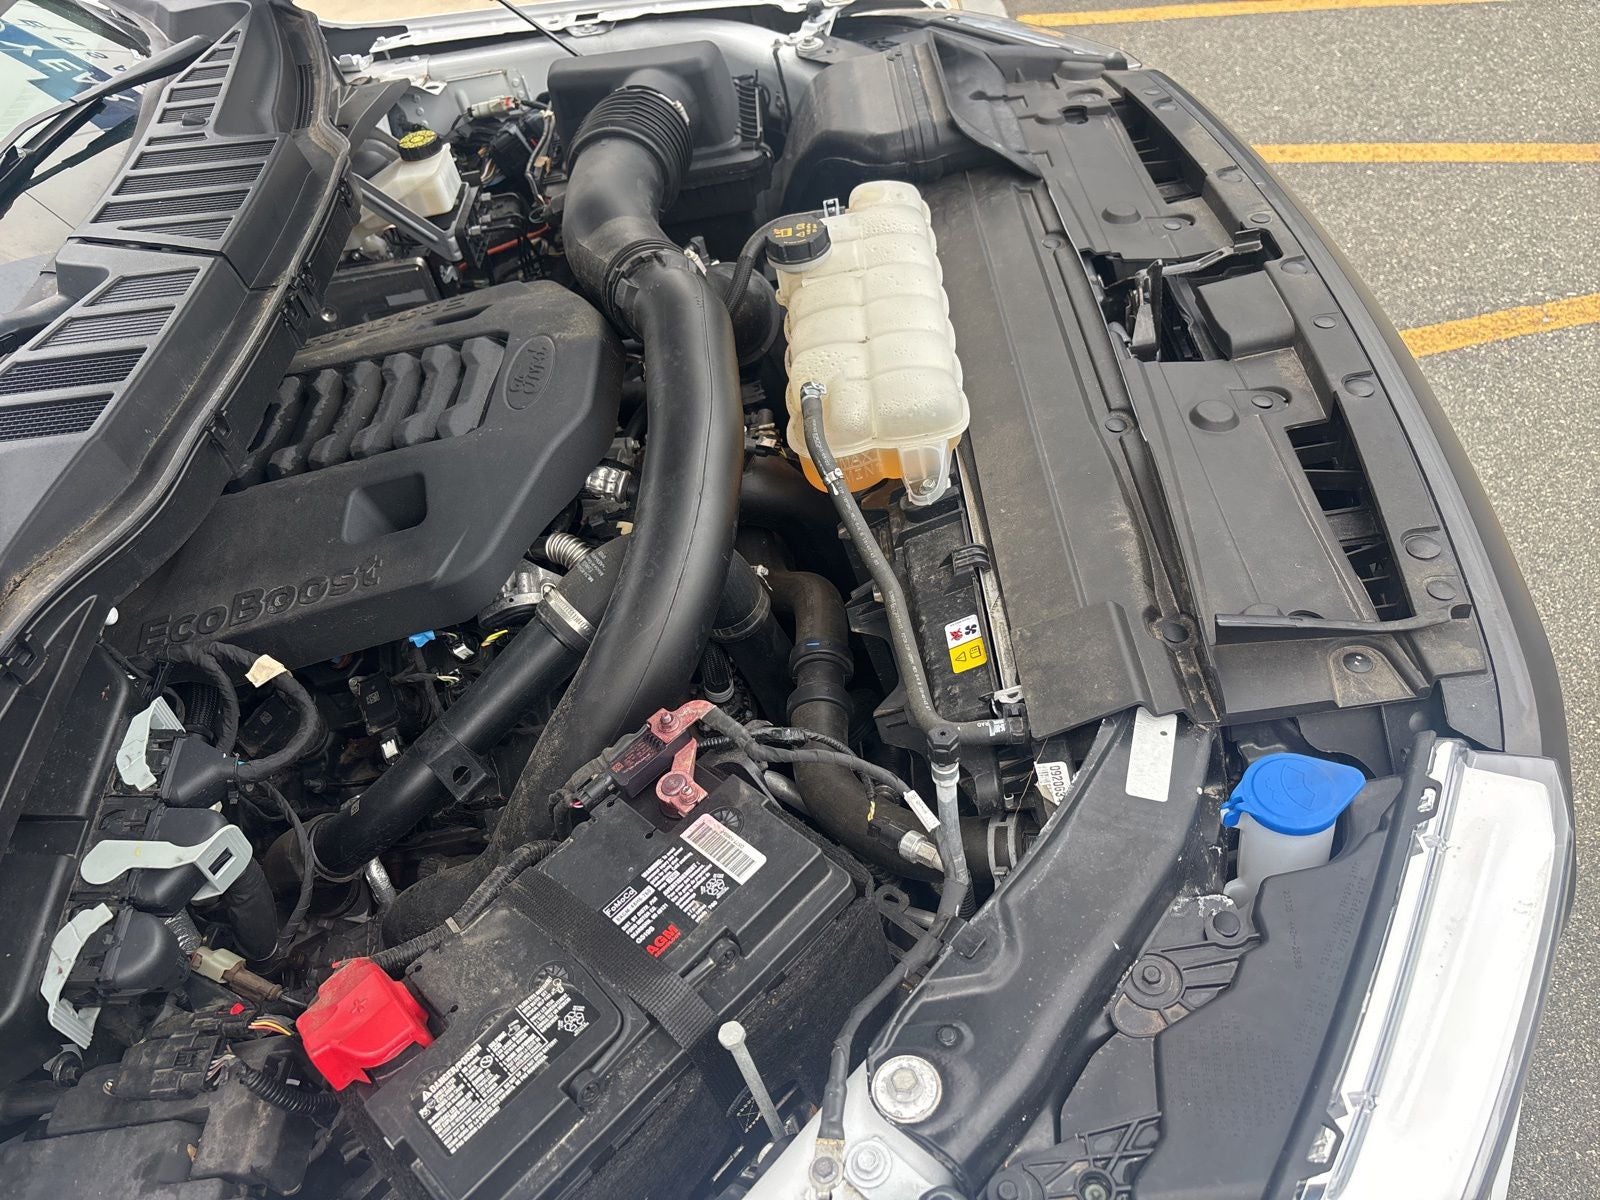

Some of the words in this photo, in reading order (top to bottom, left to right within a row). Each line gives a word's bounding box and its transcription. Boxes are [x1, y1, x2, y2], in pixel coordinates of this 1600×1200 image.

[137, 555, 382, 654] EcoBoost
[1049, 765, 1067, 802] 092063
[604, 887, 634, 916] FoMoCo
[644, 922, 679, 955] AGM
[428, 1042, 482, 1094] DANGER/POISON
